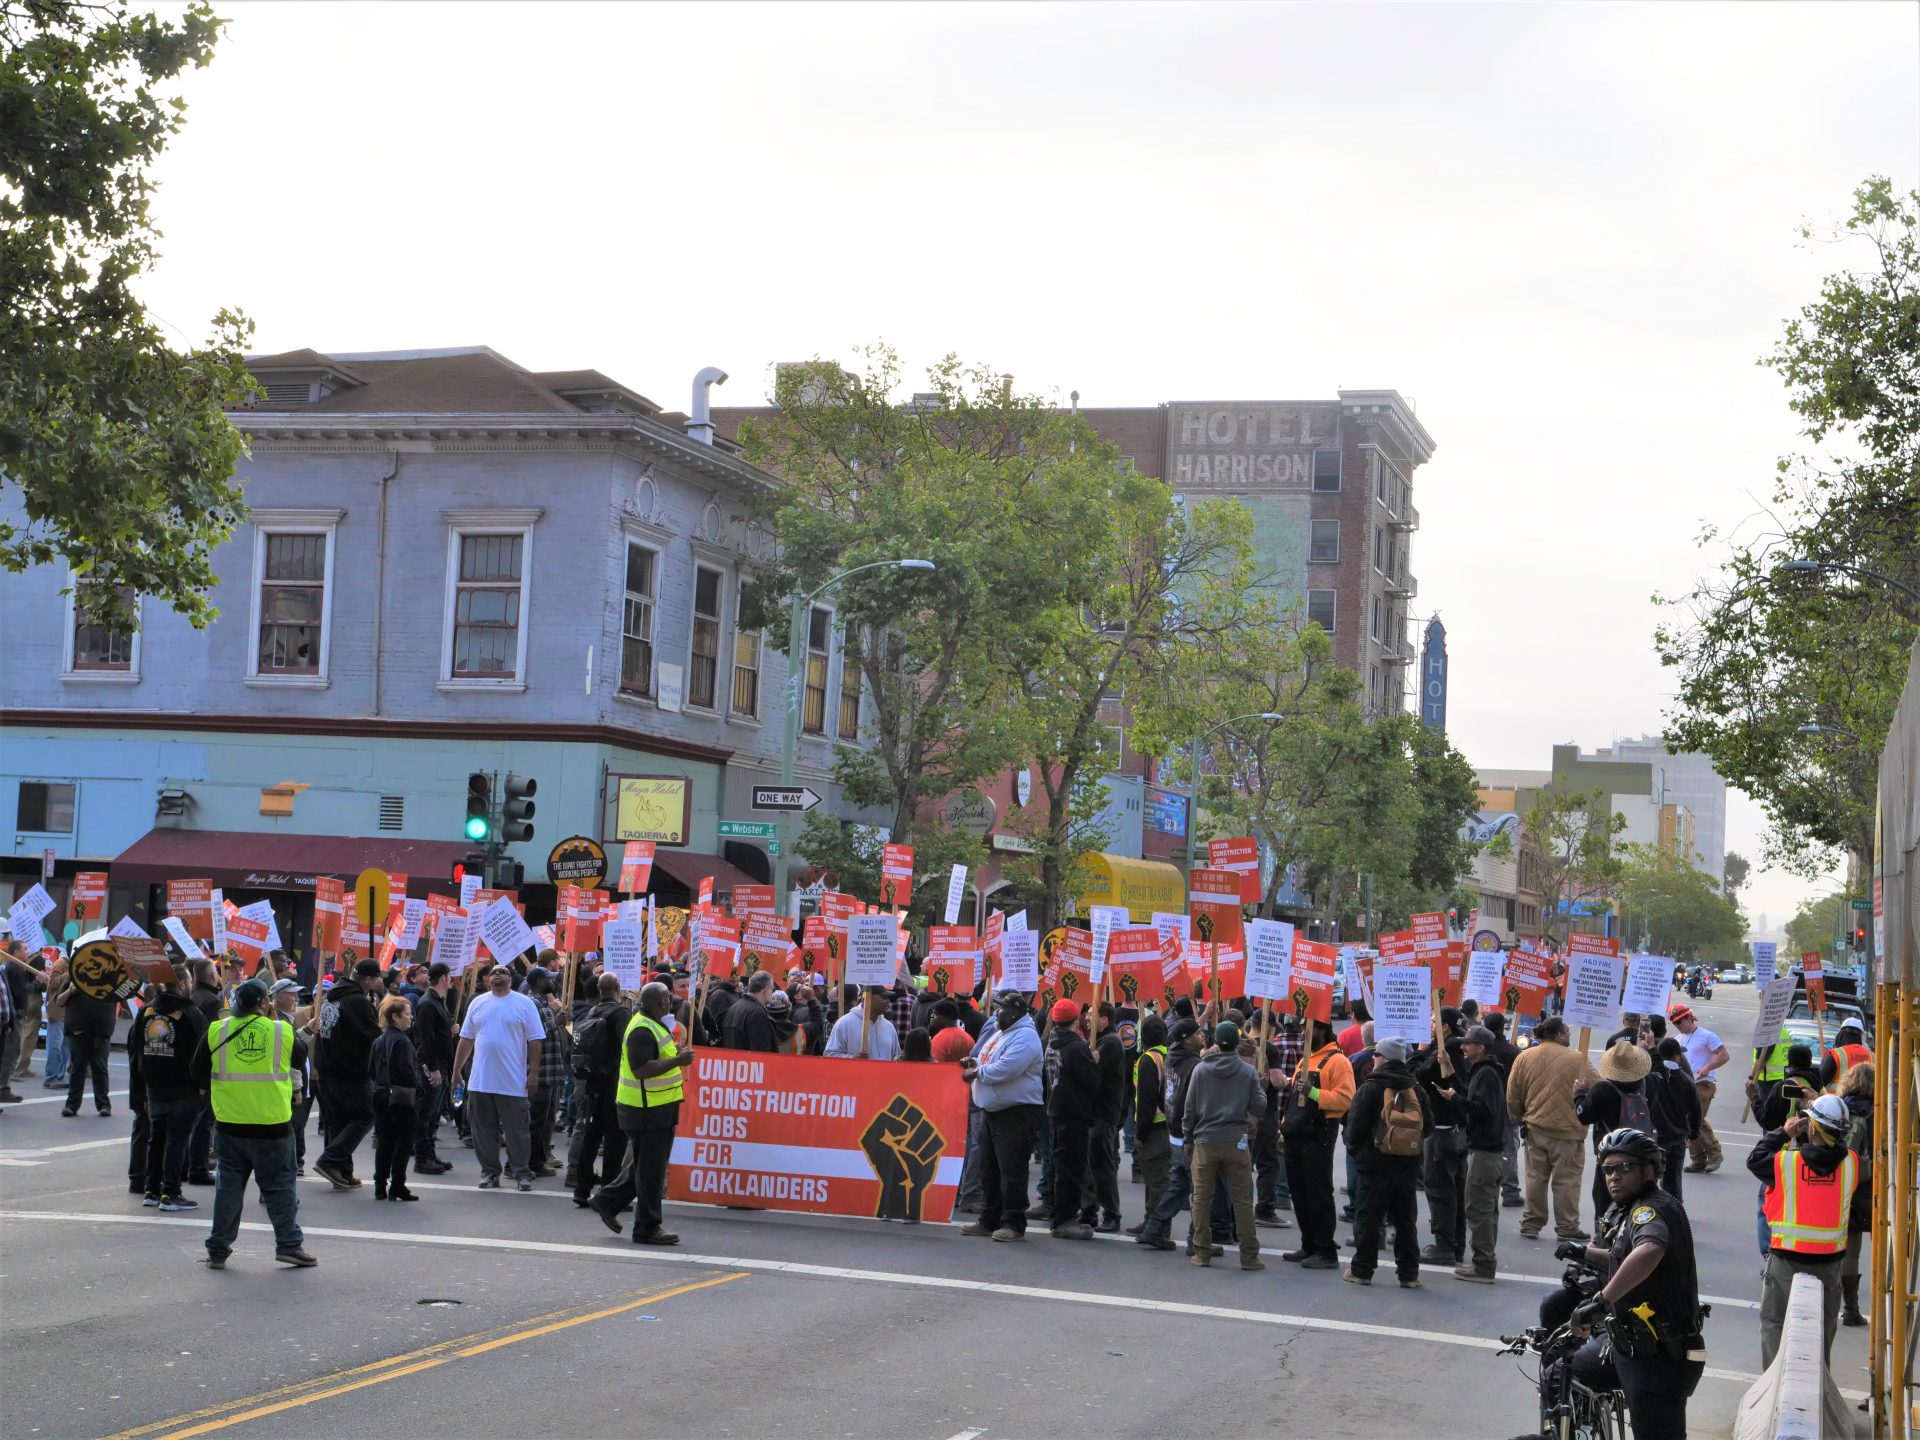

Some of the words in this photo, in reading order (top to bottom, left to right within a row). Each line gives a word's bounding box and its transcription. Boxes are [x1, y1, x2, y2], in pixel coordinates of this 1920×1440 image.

[1181, 411, 1322, 445] HOTEL
[1176, 454, 1310, 483] HARRISON
[622, 781, 649, 796] Maya
[650, 781, 682, 796] Halal
[759, 793, 779, 803] ONE
[782, 794, 802, 804] WAY
[732, 824, 764, 834] Webster
[622, 830, 668, 841] TAQUERIA
[1212, 842, 1228, 850] UNION
[1213, 848, 1252, 857] CONSTRUCTION
[553, 862, 562, 871] THE
[593, 859, 602, 867] FOR
[580, 868, 597, 877] PEOPLE
[796, 888, 839, 896] OAKL
[750, 914, 776, 924] TRABAJOS
[747, 928, 755, 936] DE
[749, 921, 787, 934] CONSTRUCCIÓN
[746, 935, 760, 943] PARA
[1068, 930, 1085, 941] UNION
[1572, 935, 1602, 946] TRABAJOS
[744, 943, 778, 954] OAKLANDERS
[1296, 943, 1312, 953] UNION
[1571, 943, 1613, 955] CONSTRUCCIÓN
[1296, 952, 1332, 966] CONSTRUCTION
[1513, 951, 1537, 963] TRABAJOS
[1583, 958, 1597, 966] A&D
[1295, 961, 1307, 969] JOBS
[1511, 958, 1546, 972] CONSTRUCCIÓN
[1293, 977, 1326, 990] OAKLANDERS
[1586, 974, 1611, 983] EMPLOYEES
[114, 978, 138, 999] IUPA
[1506, 978, 1537, 991] OAKLANDERS
[1577, 985, 1604, 995] ESTABLISHED
[1593, 981, 1616, 990] STANDARD
[1576, 998, 1593, 1006] SIMILAR
[699, 1058, 764, 1084] UNION
[699, 1087, 856, 1118] CONSTRUCTION
[695, 1114, 748, 1139] JOBS
[693, 1142, 732, 1165] FOR
[689, 1169, 828, 1203] OAKLANDERS
